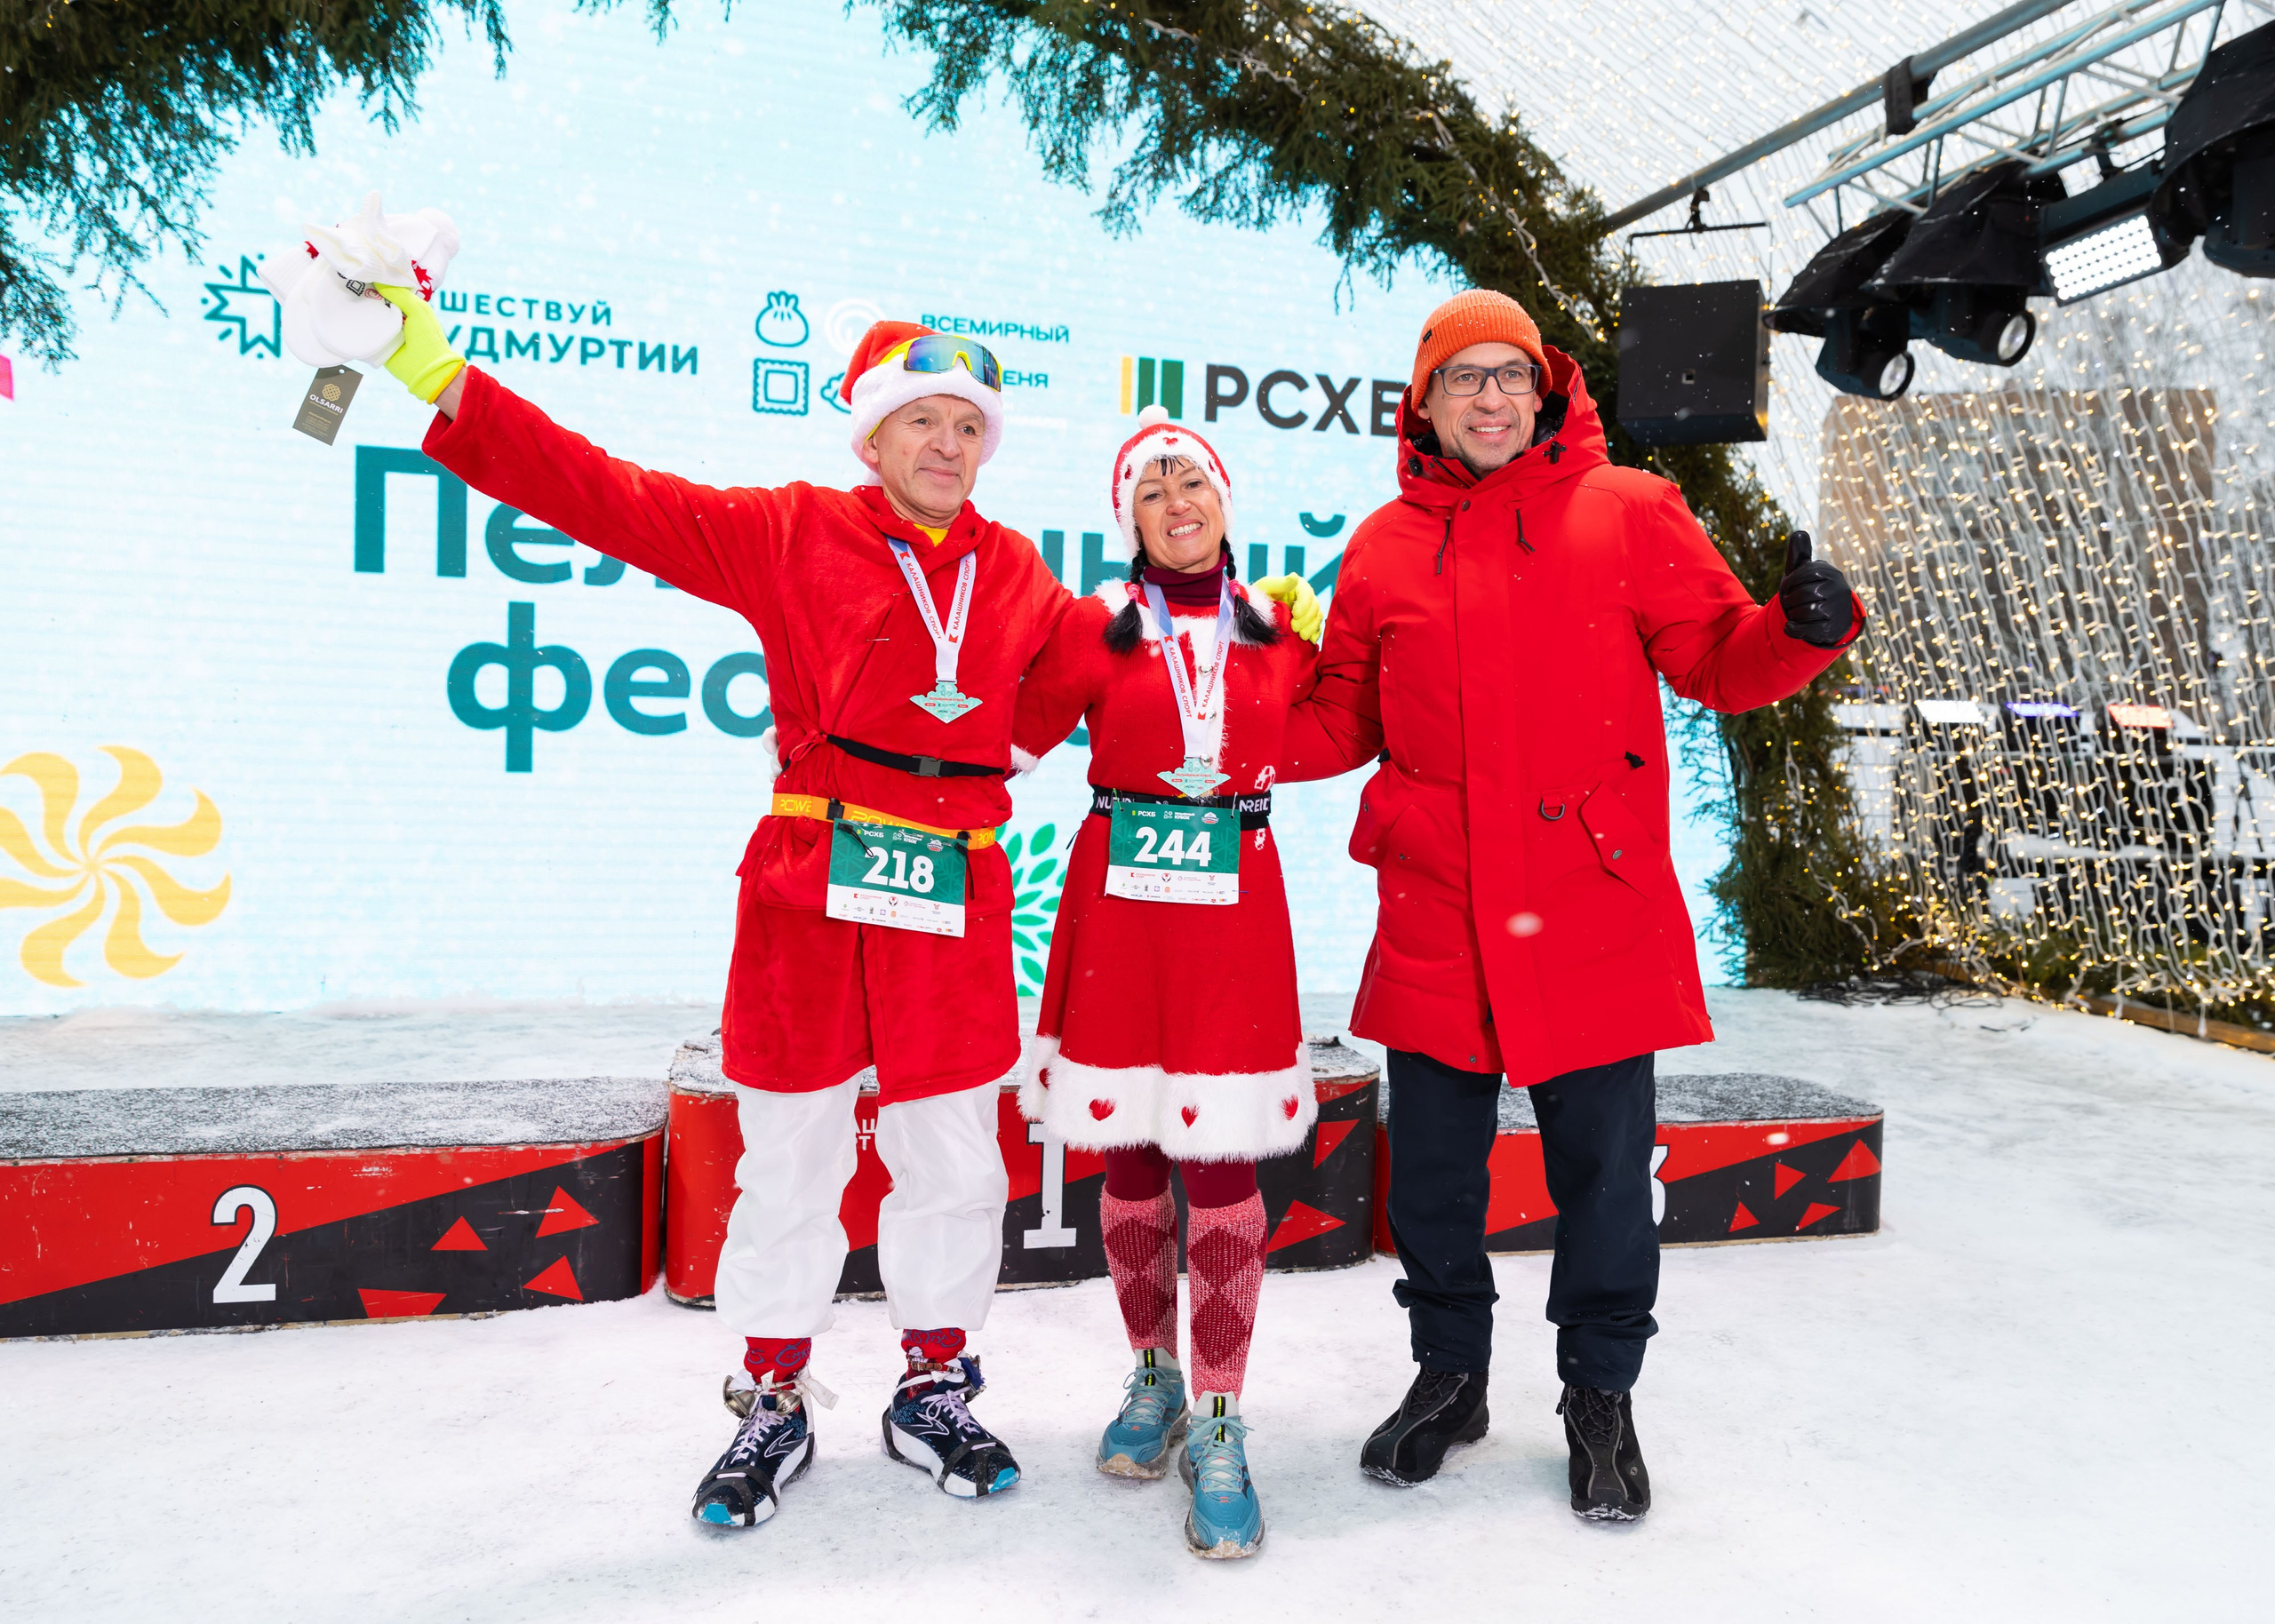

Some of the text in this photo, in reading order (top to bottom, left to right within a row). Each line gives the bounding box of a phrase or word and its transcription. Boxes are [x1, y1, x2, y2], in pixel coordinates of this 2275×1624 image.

[439, 291, 611, 326] ШЕСТВУЙ
[922, 314, 1070, 343] ВСЕМИРНЫЙ
[309, 394, 344, 414] OLSARRI
[906, 562, 942, 640] КАЛАШНИКОВ СПОРТ
[953, 582, 968, 631] КАЛАШНИКОВ
[1169, 647, 1193, 719] КАЛАШНИКОВ СПОРТ
[1201, 662, 1220, 708] КАЛАШНИКОВ
[861, 846, 935, 894] 218
[1133, 826, 1212, 867] 244
[212, 1184, 277, 1304] 2
